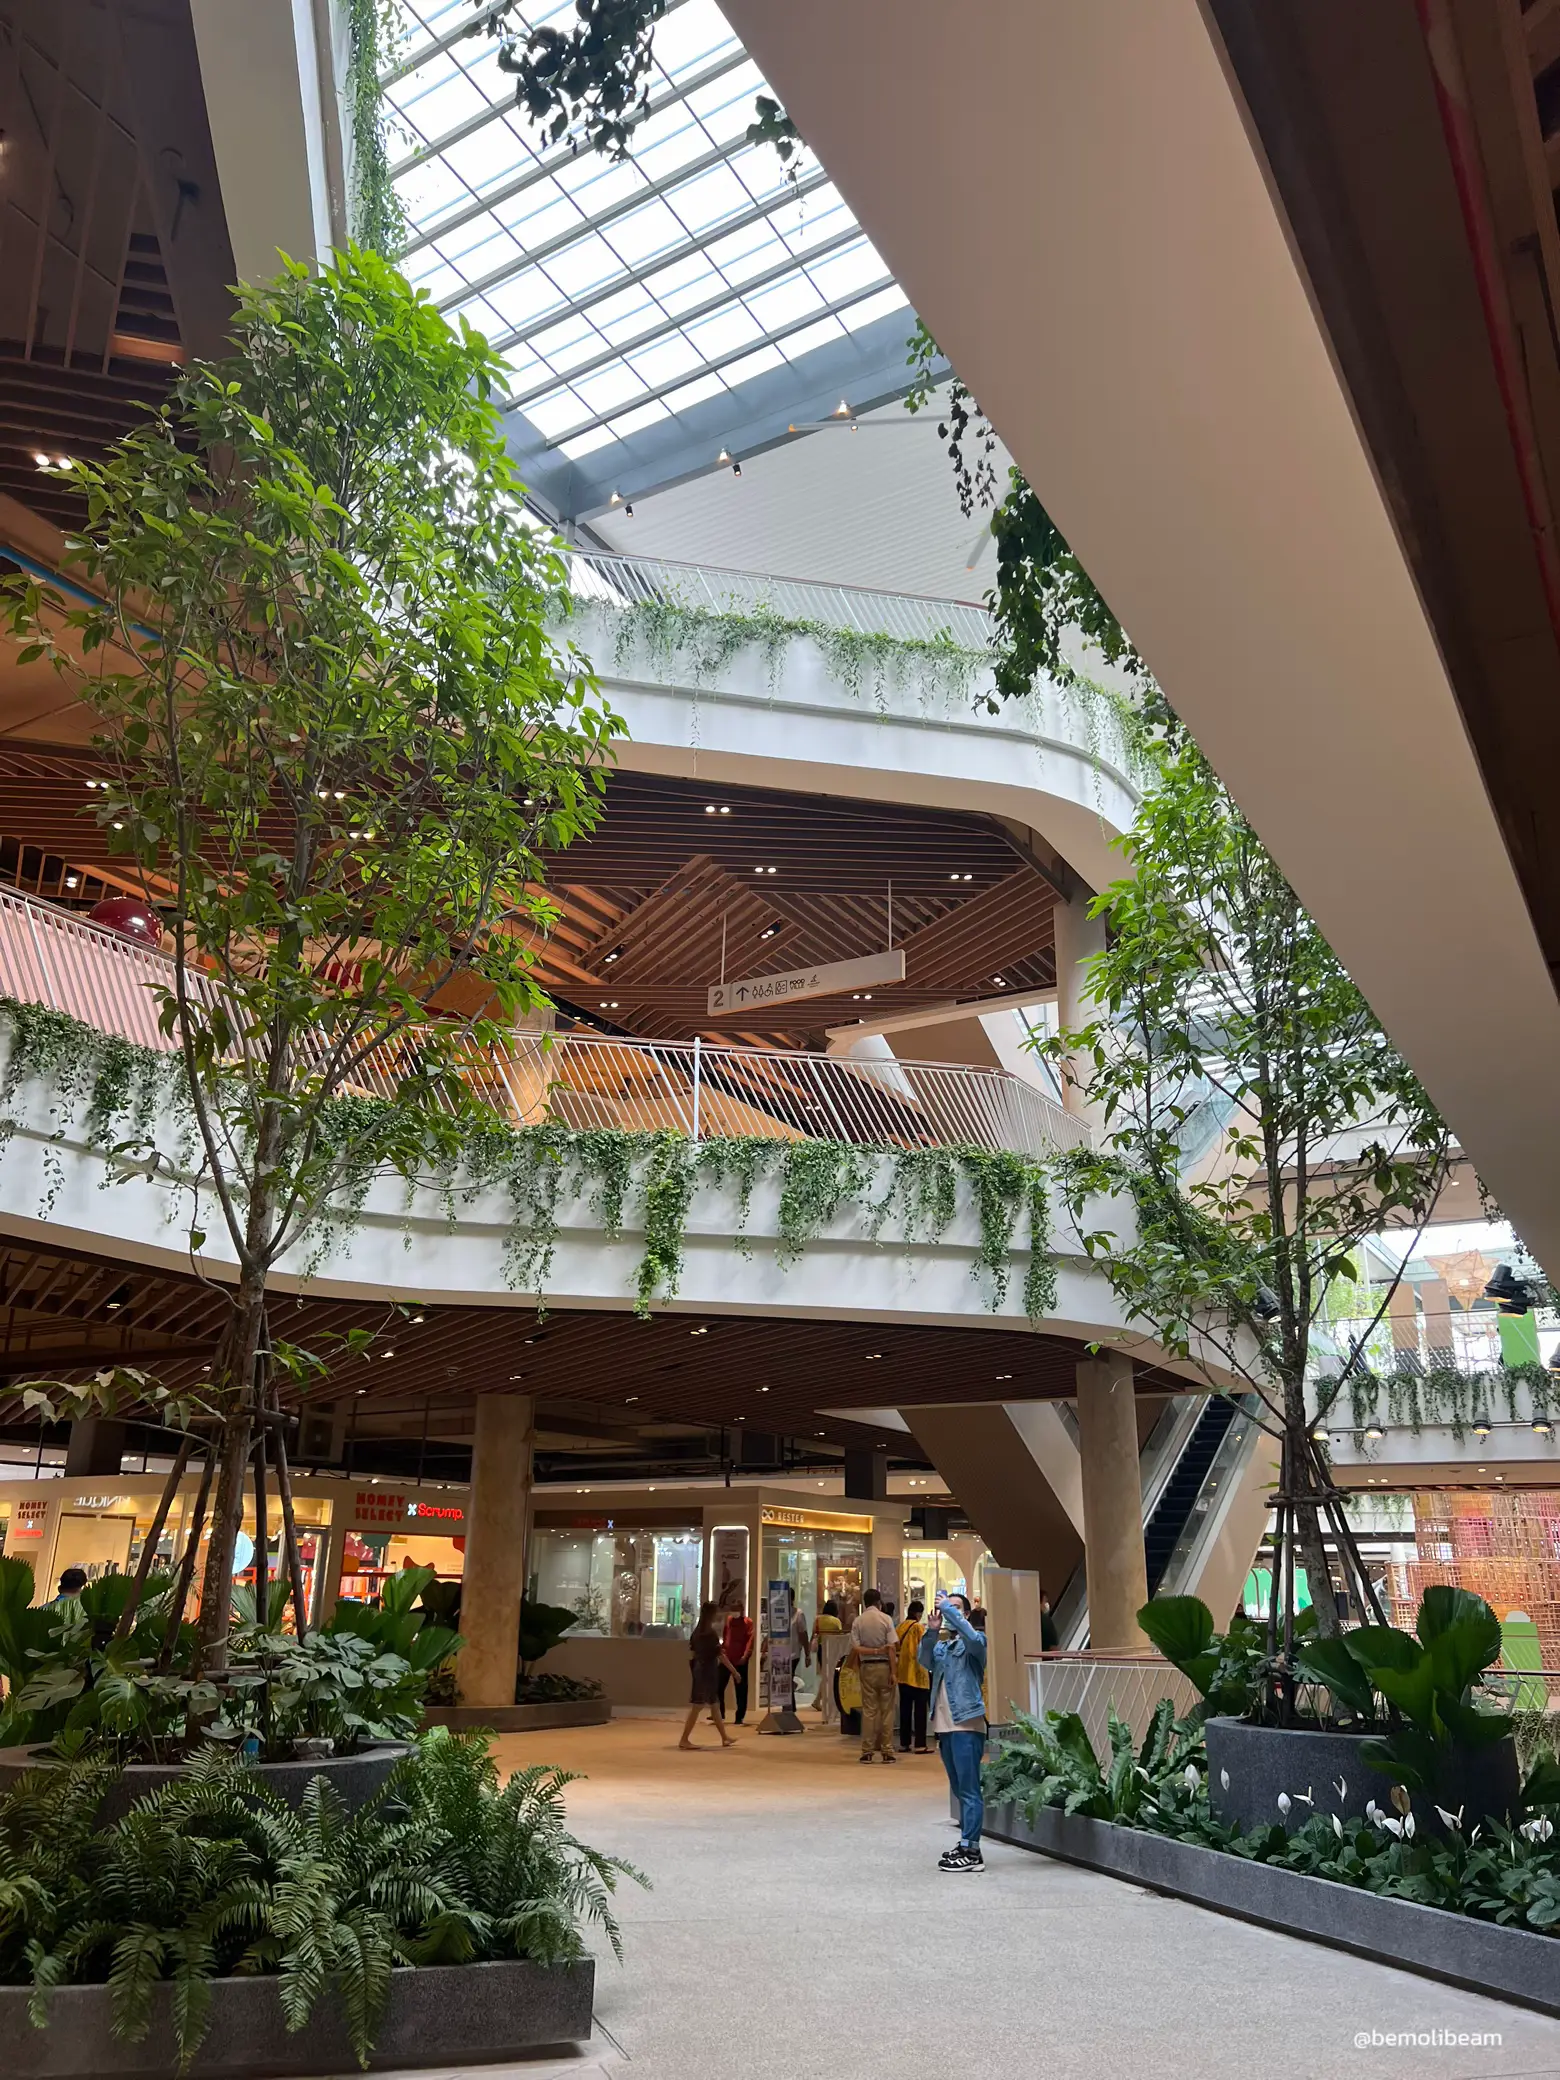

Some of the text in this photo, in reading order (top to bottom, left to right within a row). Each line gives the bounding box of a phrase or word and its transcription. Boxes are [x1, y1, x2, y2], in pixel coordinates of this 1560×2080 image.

[713, 990, 724, 1008] 2
[17, 1510, 47, 1519] SELECT
[355, 1507, 405, 1522] SELECT
[418, 1502, 465, 1521] Scrump.
[777, 1511, 805, 1523] RESTER
